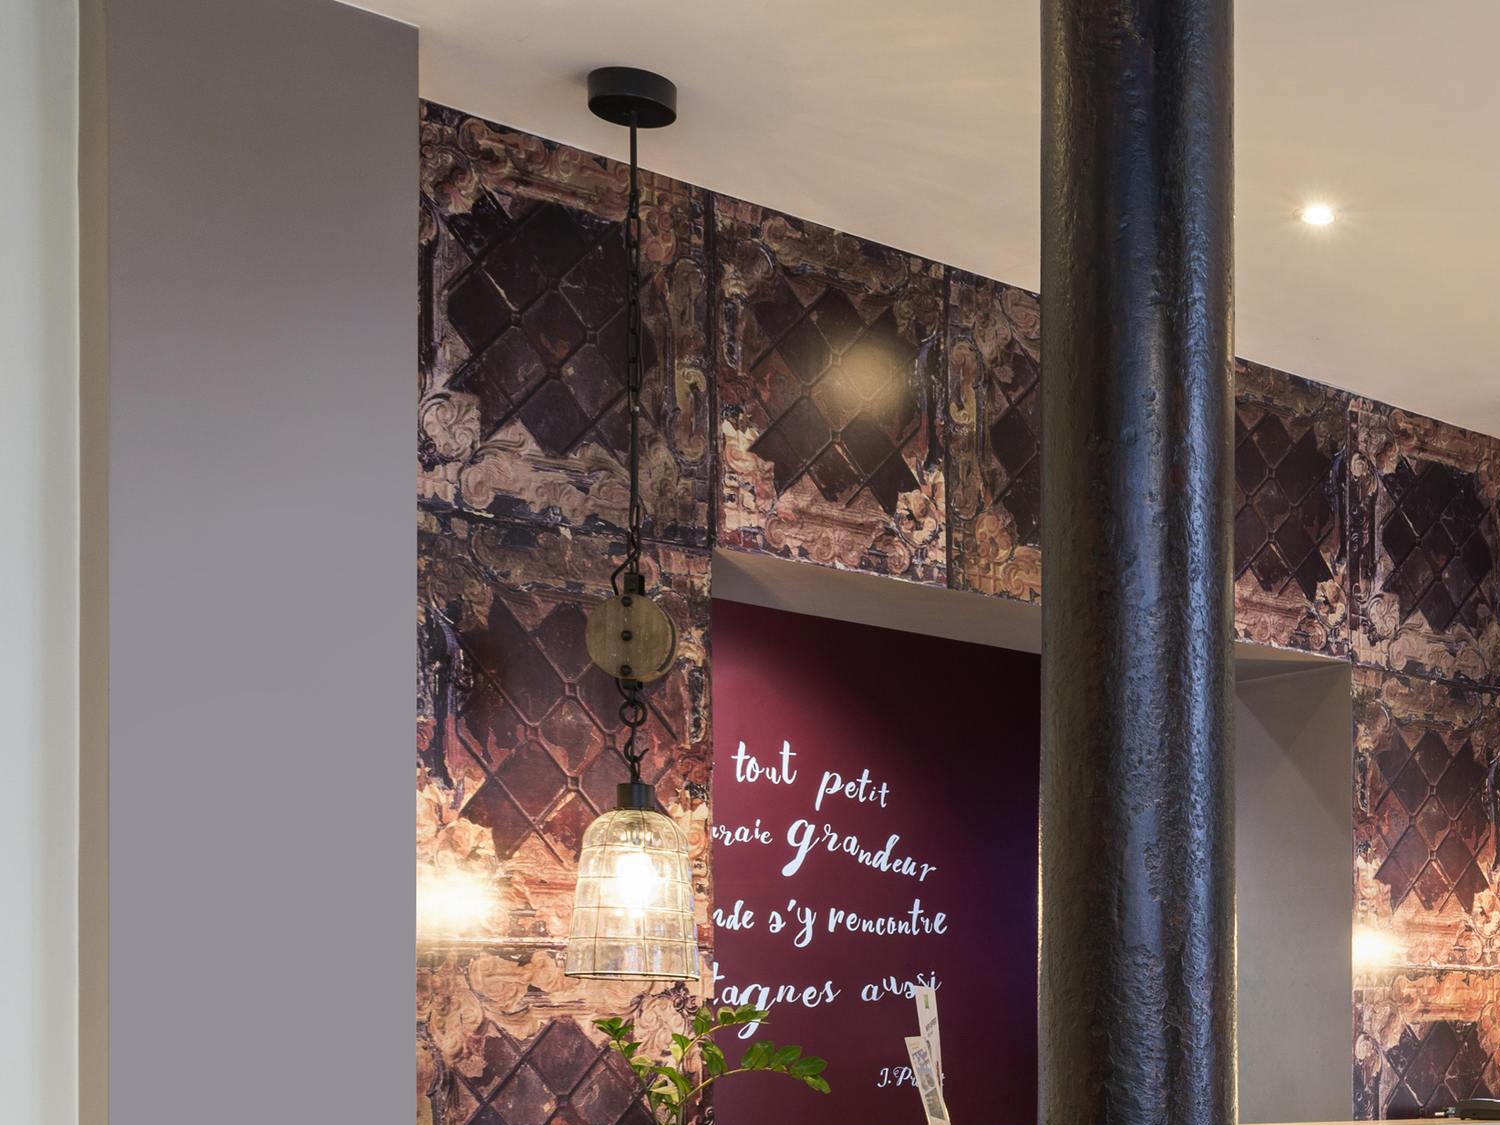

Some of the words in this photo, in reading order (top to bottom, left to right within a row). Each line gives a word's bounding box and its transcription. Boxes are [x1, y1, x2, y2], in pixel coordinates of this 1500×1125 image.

[731, 739, 797, 785] tout
[814, 768, 890, 811] petit
[781, 818, 937, 882] grandeur
[768, 899, 817, 948] s'y
[828, 898, 948, 936] rencontre
